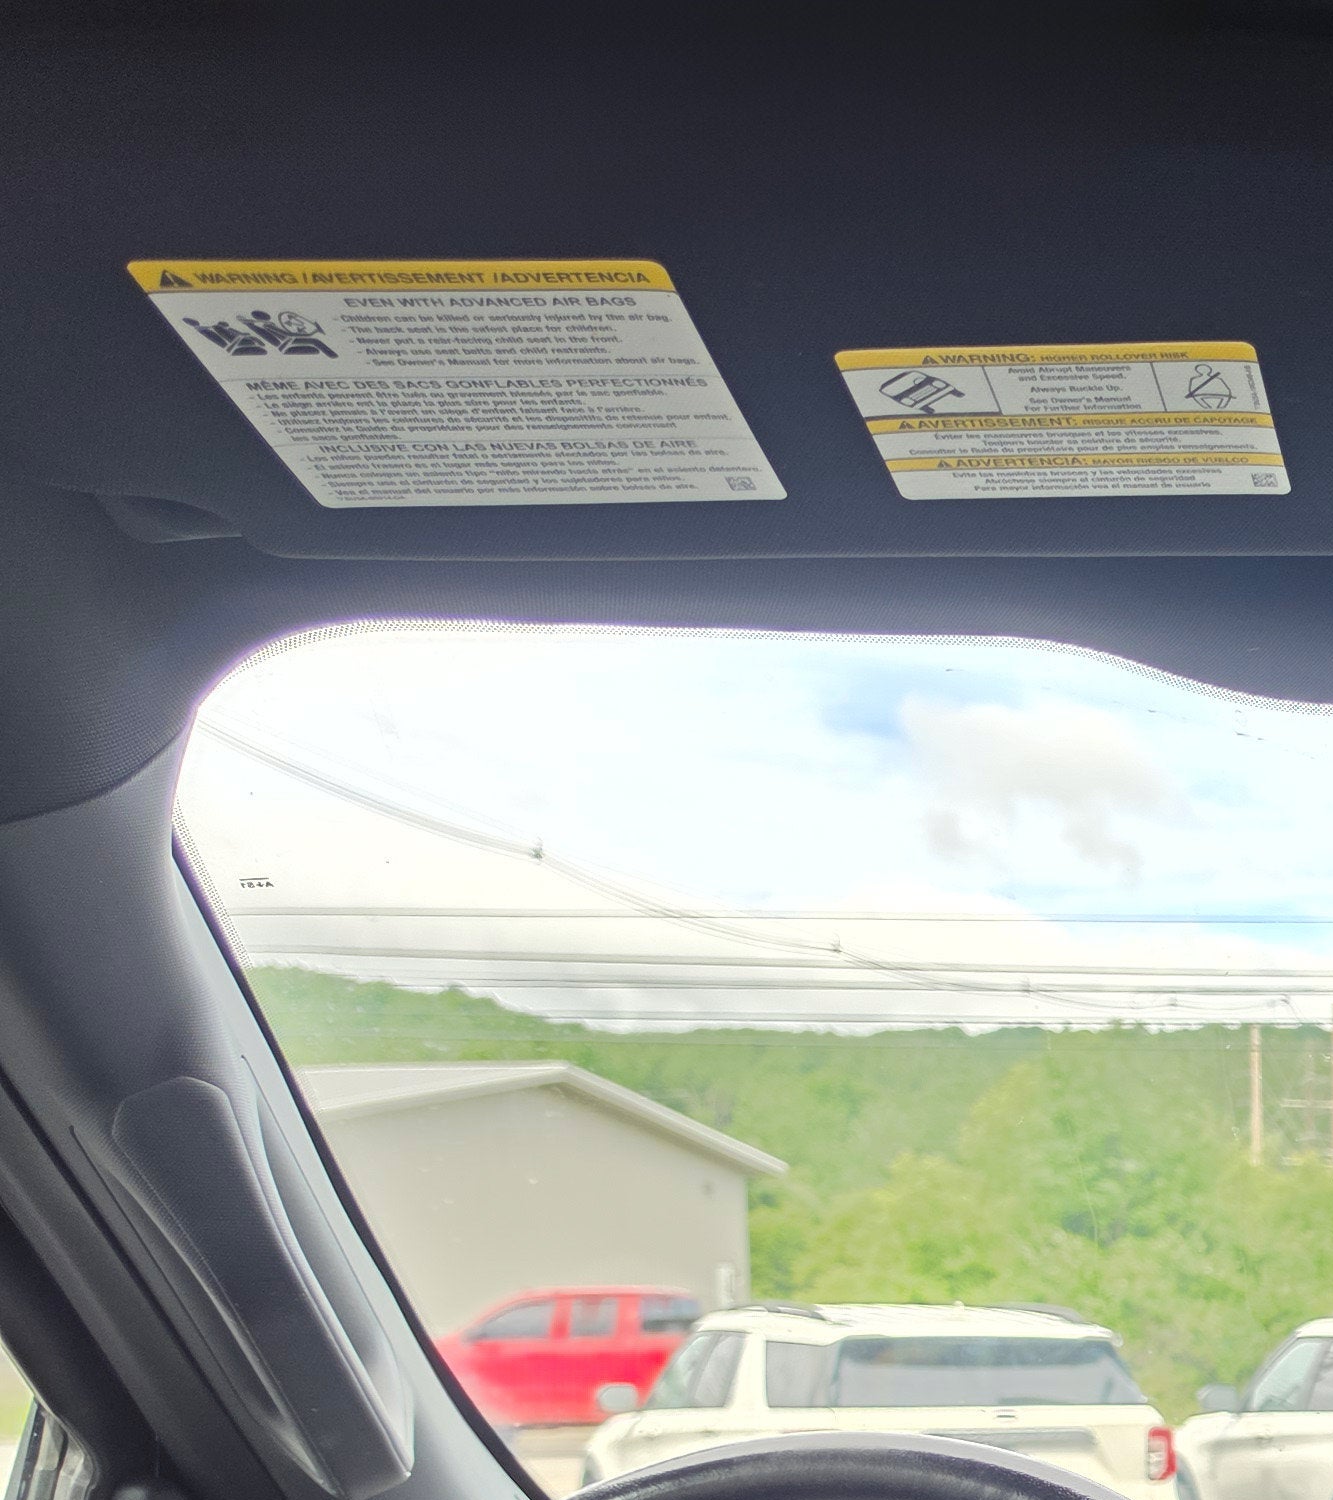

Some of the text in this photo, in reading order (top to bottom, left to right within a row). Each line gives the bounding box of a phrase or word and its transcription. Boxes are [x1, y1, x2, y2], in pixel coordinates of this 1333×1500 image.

[195, 272, 299, 284] WARNING
[343, 296, 637, 308] EVEN WITH ADVANCED AIR BAGS
[304, 380, 351, 391] AVEC
[353, 380, 390, 390] DES
[393, 379, 443, 390] SACS
[445, 378, 563, 390] GONFLABLES
[318, 443, 408, 454] INCLUSIVE
[411, 443, 449, 453] CON
[452, 442, 487, 452] LAS
[632, 440, 655, 450] DE
[658, 439, 698, 449] AIRE
